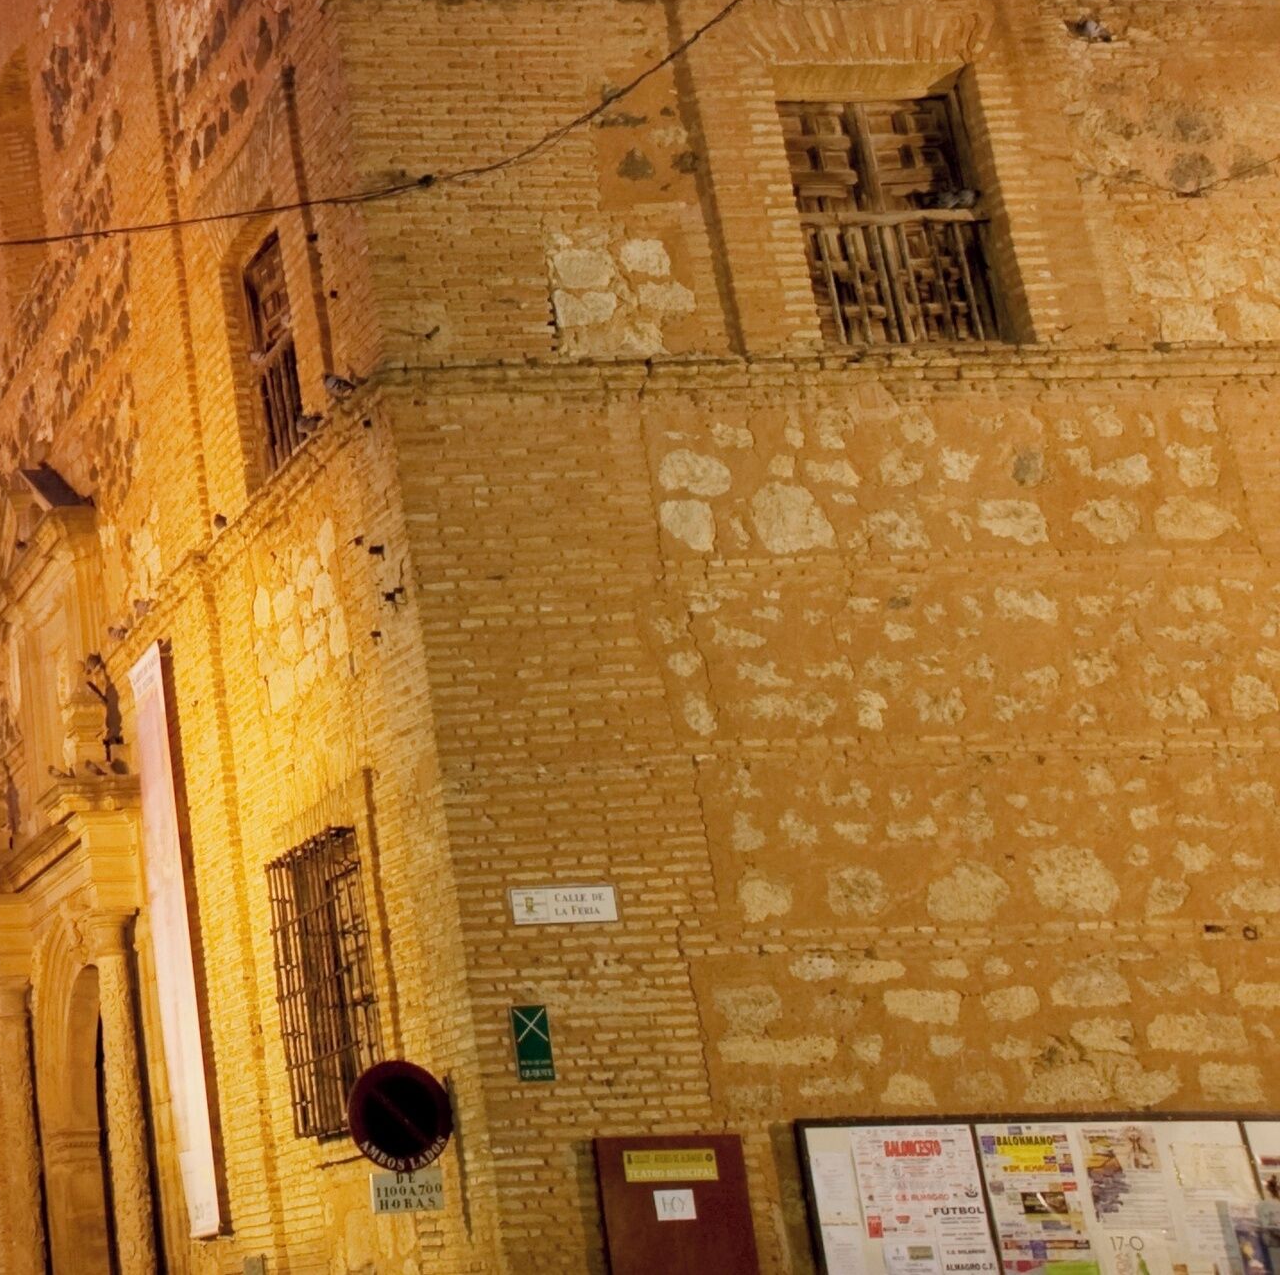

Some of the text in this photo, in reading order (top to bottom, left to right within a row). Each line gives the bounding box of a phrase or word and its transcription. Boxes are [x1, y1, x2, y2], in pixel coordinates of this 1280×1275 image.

[554, 893, 588, 903] CALLE
[592, 892, 605, 901] DE
[571, 905, 601, 916] FERIA
[996, 1135, 1053, 1146] BALONMANO
[360, 1135, 446, 1171] AMBOS LADOS
[883, 1139, 942, 1157] BALONCESTO
[396, 1172, 415, 1184] DE
[380, 1197, 436, 1211] HORAS
